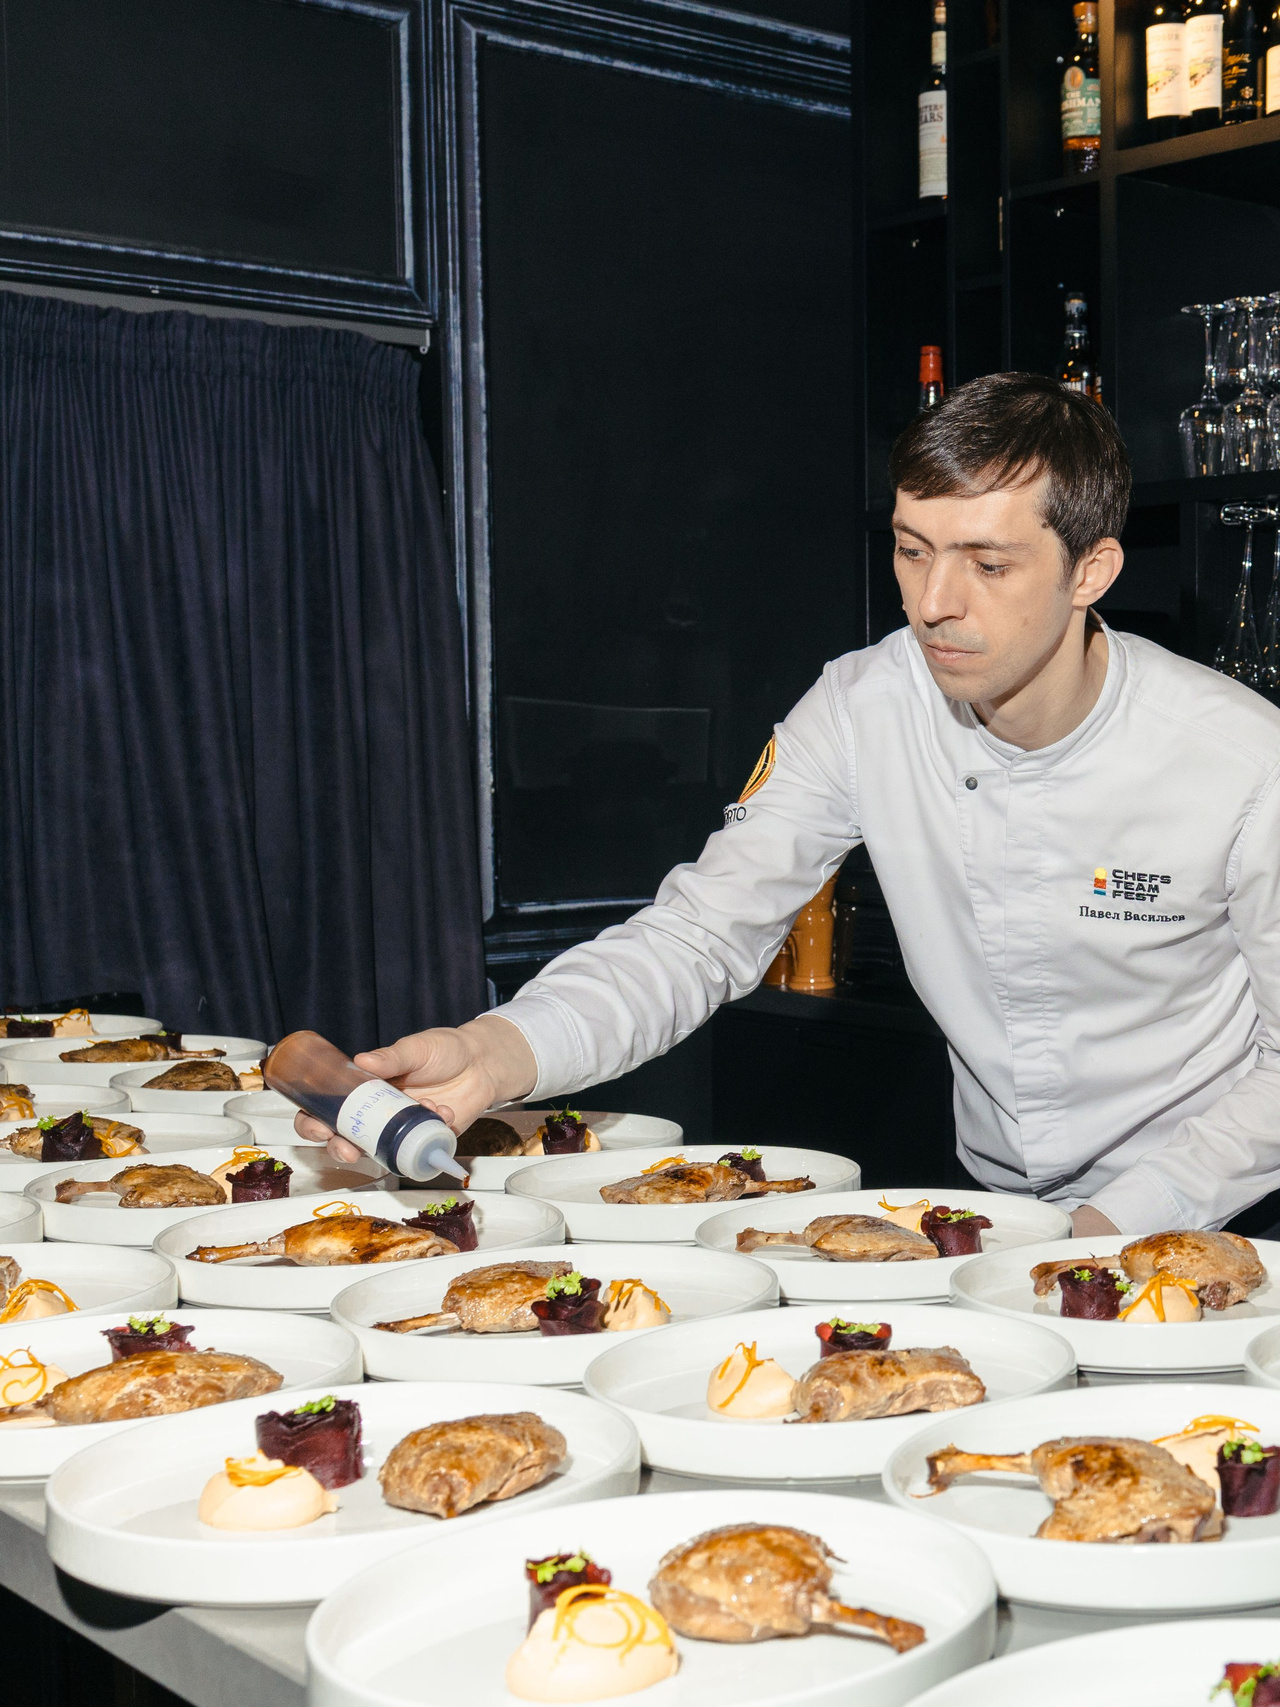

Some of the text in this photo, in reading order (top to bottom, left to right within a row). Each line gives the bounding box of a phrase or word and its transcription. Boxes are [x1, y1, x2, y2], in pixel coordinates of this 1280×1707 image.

[1112, 868, 1172, 885] CHEFS
[1112, 879, 1160, 893] TEAM
[1112, 890, 1158, 902] FEST
[1079, 905, 1186, 922] Павел Васильев
